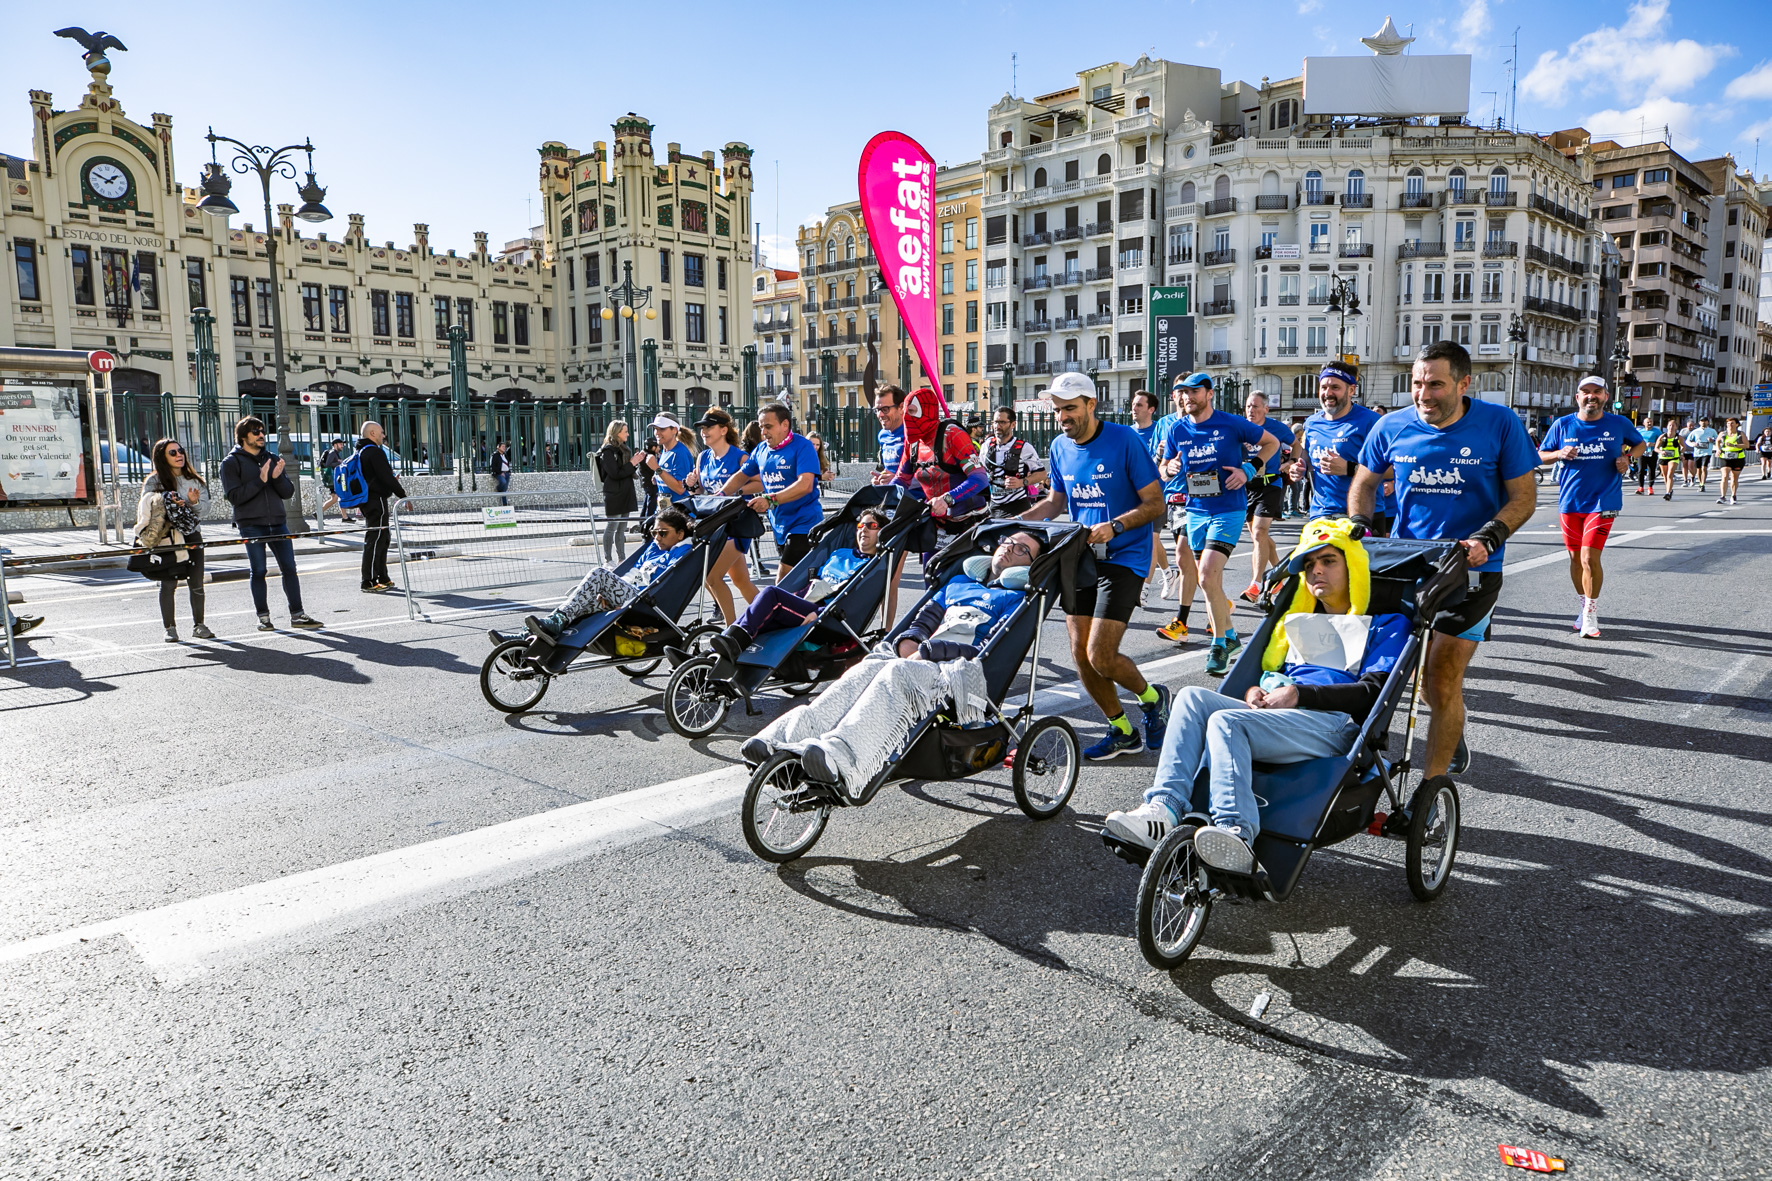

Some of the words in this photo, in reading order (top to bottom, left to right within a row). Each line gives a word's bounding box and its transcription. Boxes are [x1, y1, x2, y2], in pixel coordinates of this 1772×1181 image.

[938, 201, 967, 218] ZENIT
[890, 158, 922, 295] aefat
[919, 162, 930, 299] www.aefat.es
[63, 228, 107, 242] ESTACIÓ
[110, 233, 132, 244] DEL
[133, 236, 162, 248] NORD
[1163, 291, 1185, 299] adif
[1169, 336, 1178, 361] NORD
[7, 399, 19, 407] City
[12, 424, 57, 433] RUNNERS!
[23, 444, 35, 452] get
[38, 452, 72, 460] Valencia!
[1394, 454, 1417, 463] aefat
[1449, 457, 1481, 465] ZURICH
[1091, 472, 1113, 480] ZURICH
